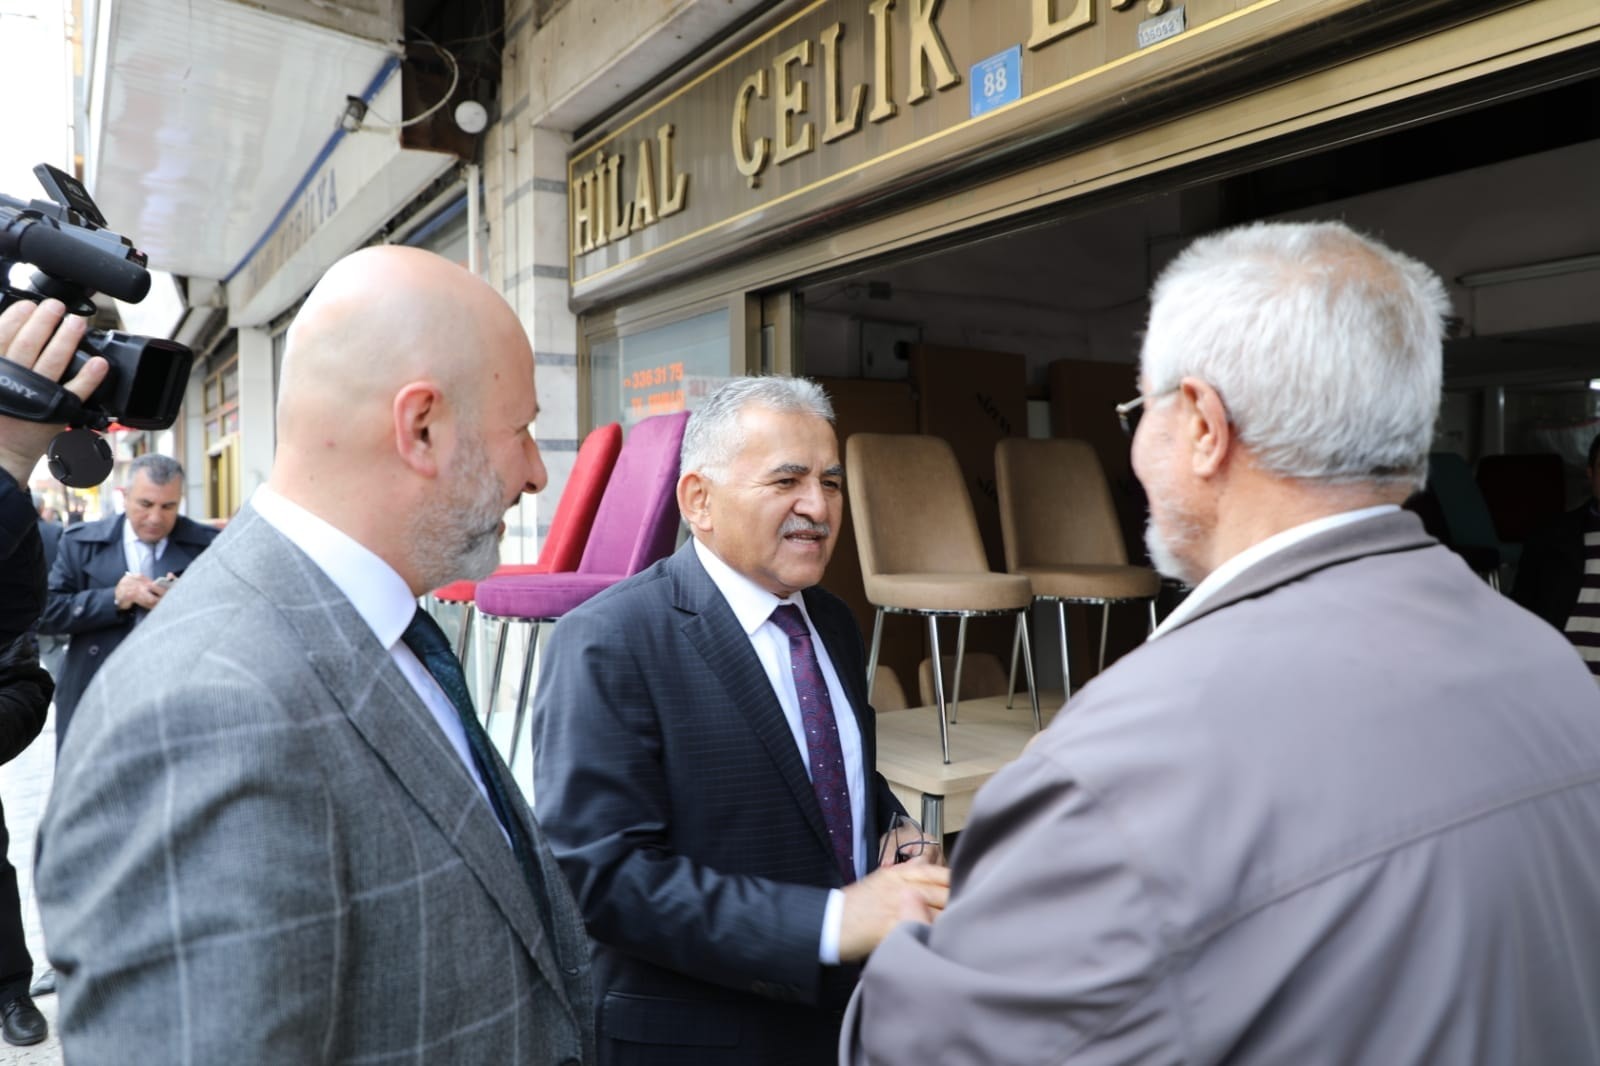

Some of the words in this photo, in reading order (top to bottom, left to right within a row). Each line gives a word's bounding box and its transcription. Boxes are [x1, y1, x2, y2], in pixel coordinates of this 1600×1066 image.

[984, 67, 1007, 97] 88
[574, 123, 689, 257] HİLAL
[0, 375, 38, 399] ONY
